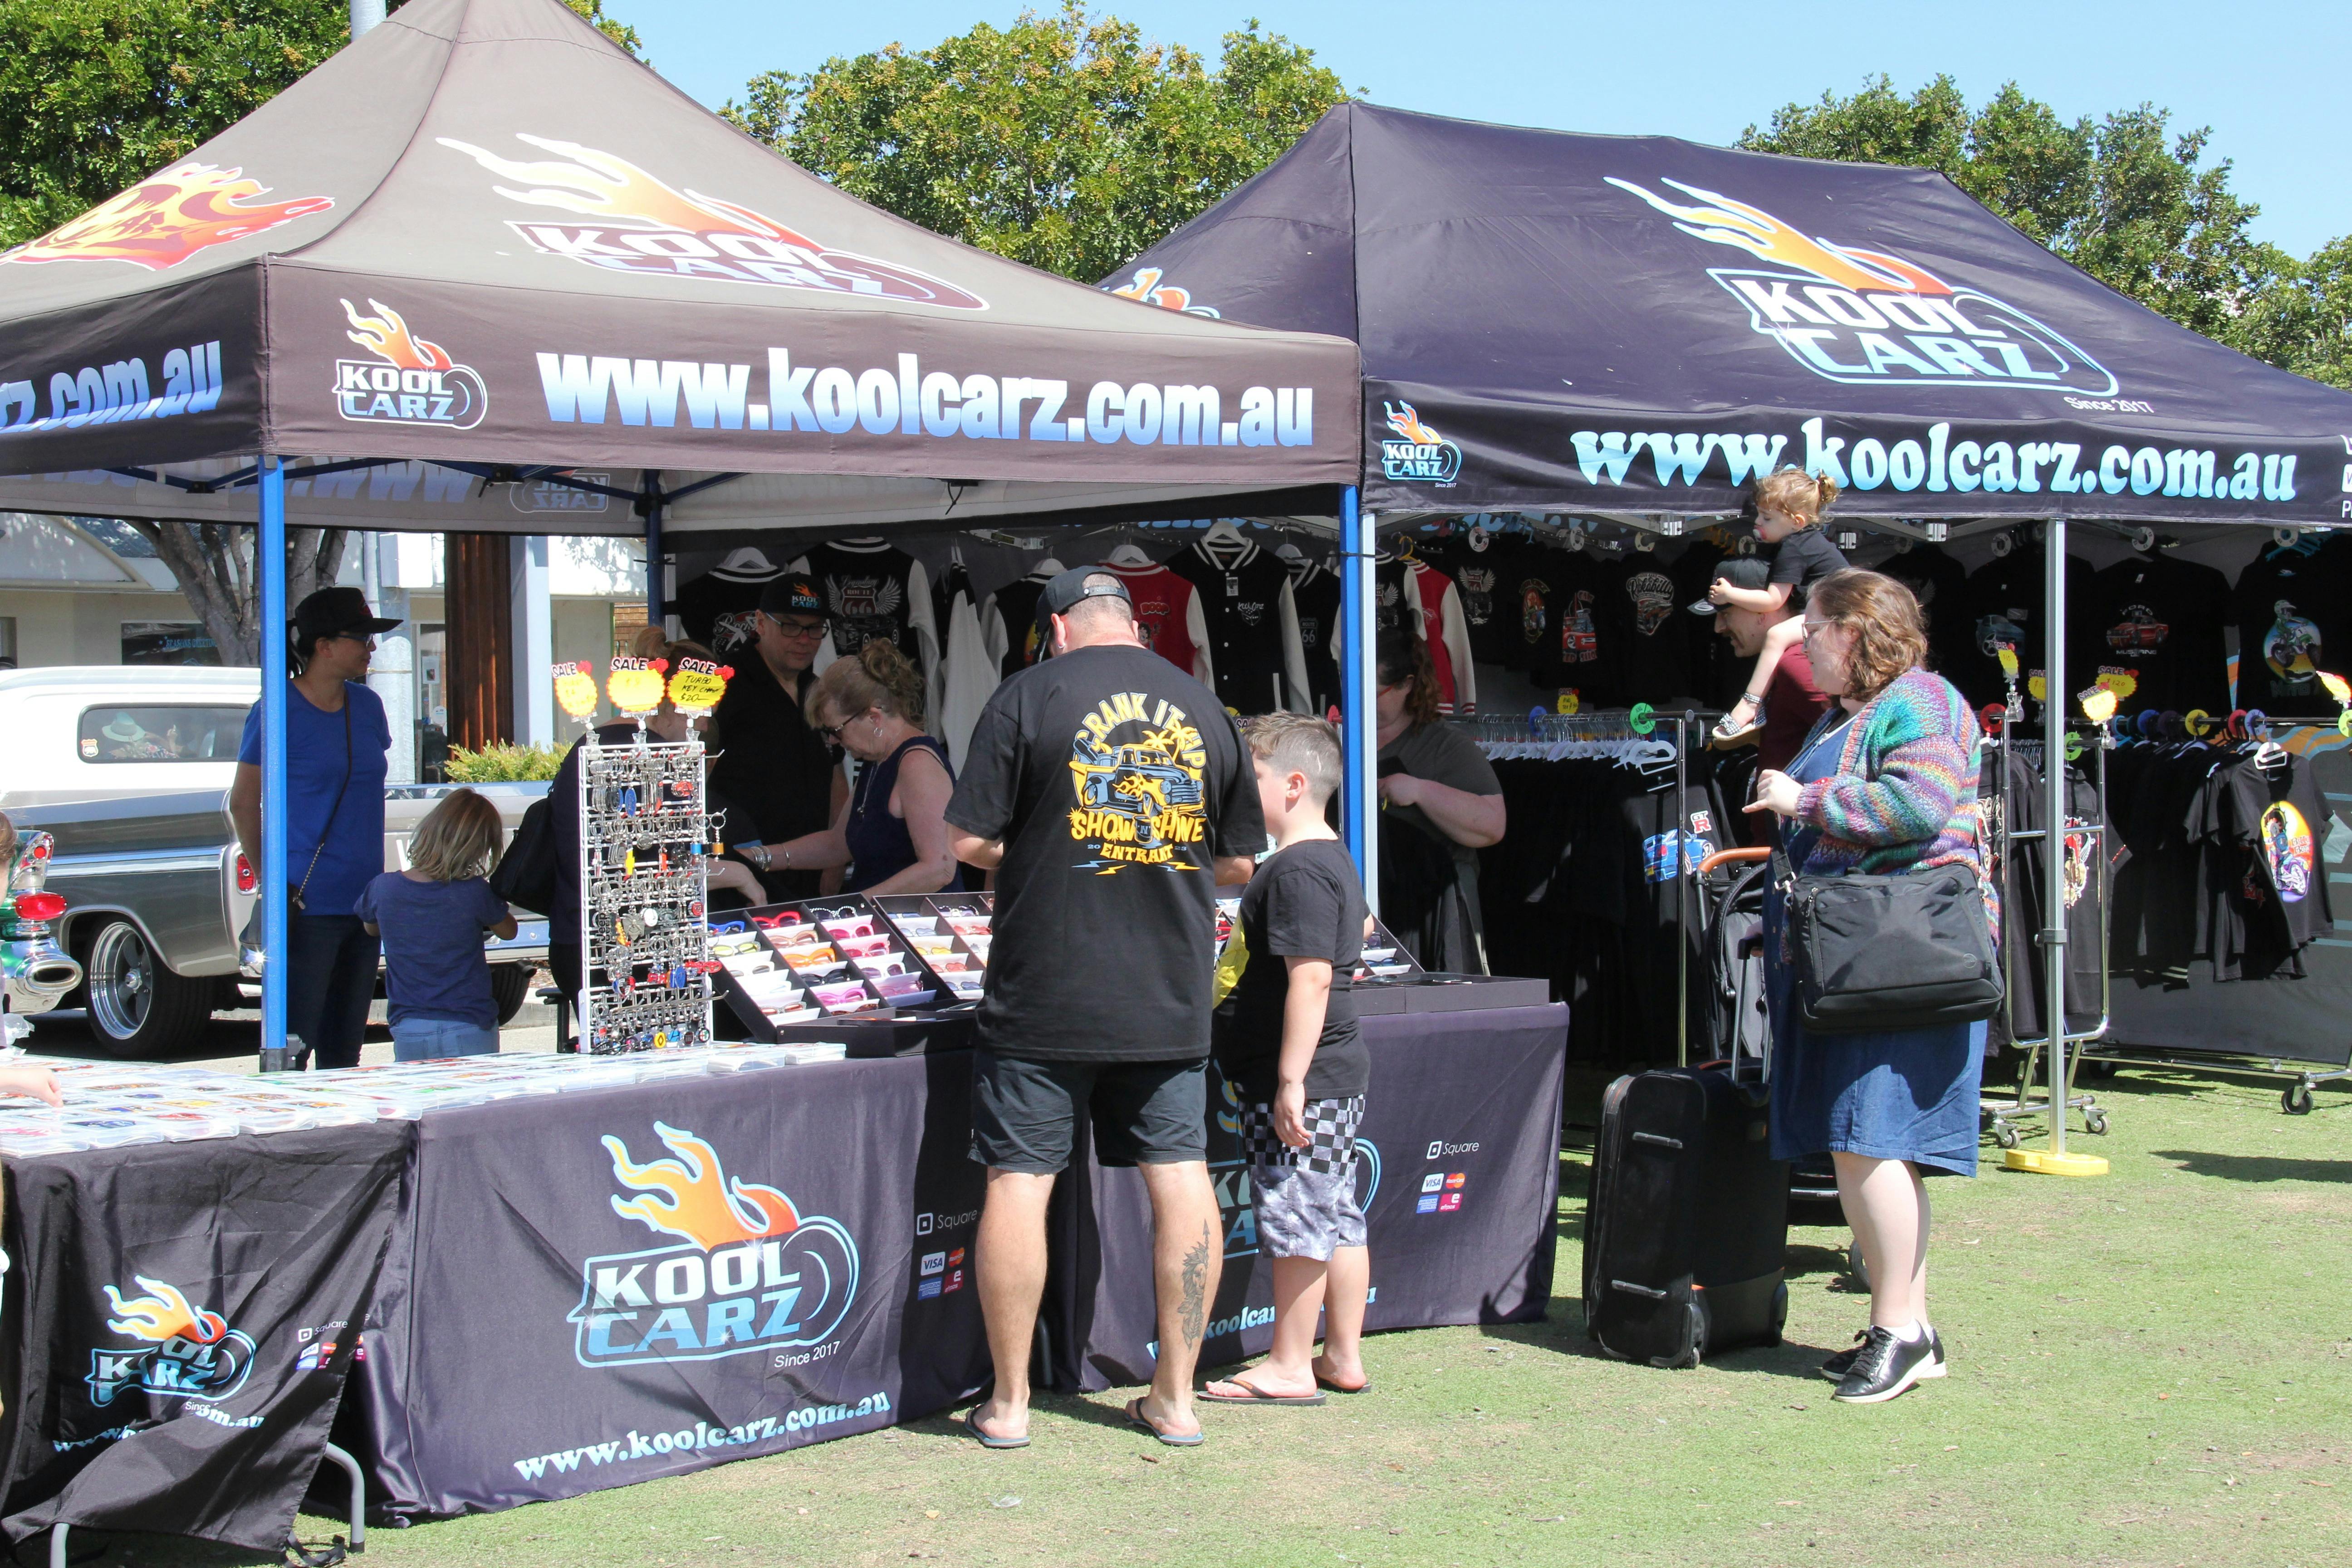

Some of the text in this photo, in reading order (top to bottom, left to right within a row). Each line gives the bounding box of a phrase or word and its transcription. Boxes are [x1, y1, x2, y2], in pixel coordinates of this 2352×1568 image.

[529, 227, 871, 279] KOOL
[573, 257, 917, 299] CARZ
[1730, 279, 2007, 339] KOOL
[1788, 331, 2062, 381] CARZ
[342, 366, 453, 395] KOOL
[343, 391, 455, 420] CARZ
[536, 348, 1313, 447] www.koolcarz.com.au
[2063, 396, 2155, 414] Since 2017
[1386, 444, 1443, 460] KOOL
[1570, 416, 2298, 502] www.koolcarz.com.au
[1387, 460, 1443, 476] CARZ
[1301, 629, 1315, 643] 66
[552, 662, 576, 678] SALE
[611, 657, 648, 671] SALE
[680, 659, 715, 675] SALE
[2098, 666, 2124, 676] SALE
[2077, 685, 2099, 702] SALE
[1075, 692, 1150, 752] CRANK
[1153, 698, 1186, 731] IT
[1070, 811, 1135, 843] SHOW
[1152, 812, 1206, 843] SHINE
[1100, 843, 1174, 864] ENTRANT
[1442, 1142, 1480, 1156] Square
[1426, 1178, 1441, 1187] VISA
[937, 1210, 978, 1230] Square
[592, 1241, 800, 1310] KOOL
[923, 1256, 943, 1270] VISA
[588, 1287, 803, 1357] CARZ
[774, 1340, 841, 1369] Since 2017
[513, 1390, 891, 1481] www.koolcarz.com.au
